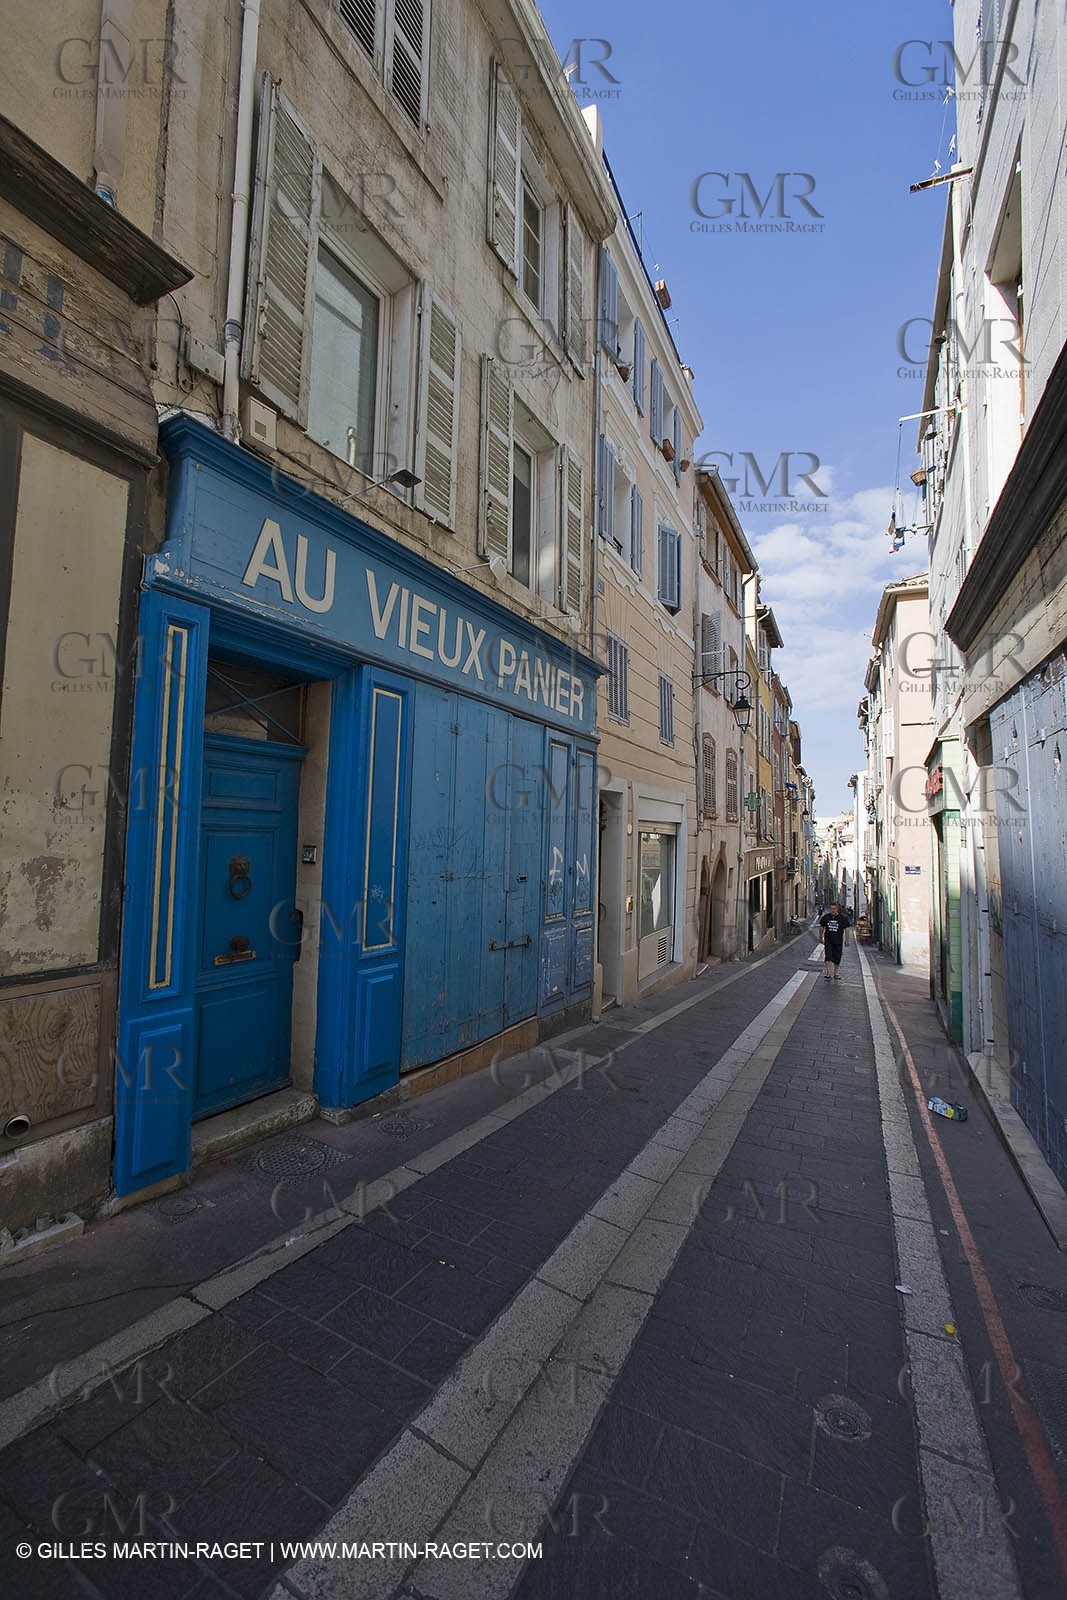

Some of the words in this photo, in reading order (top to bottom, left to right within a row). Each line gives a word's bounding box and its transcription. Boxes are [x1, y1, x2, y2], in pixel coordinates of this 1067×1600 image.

[242, 517, 337, 614] AU
[366, 568, 487, 681] VIEUX
[497, 638, 585, 721] PANIER
